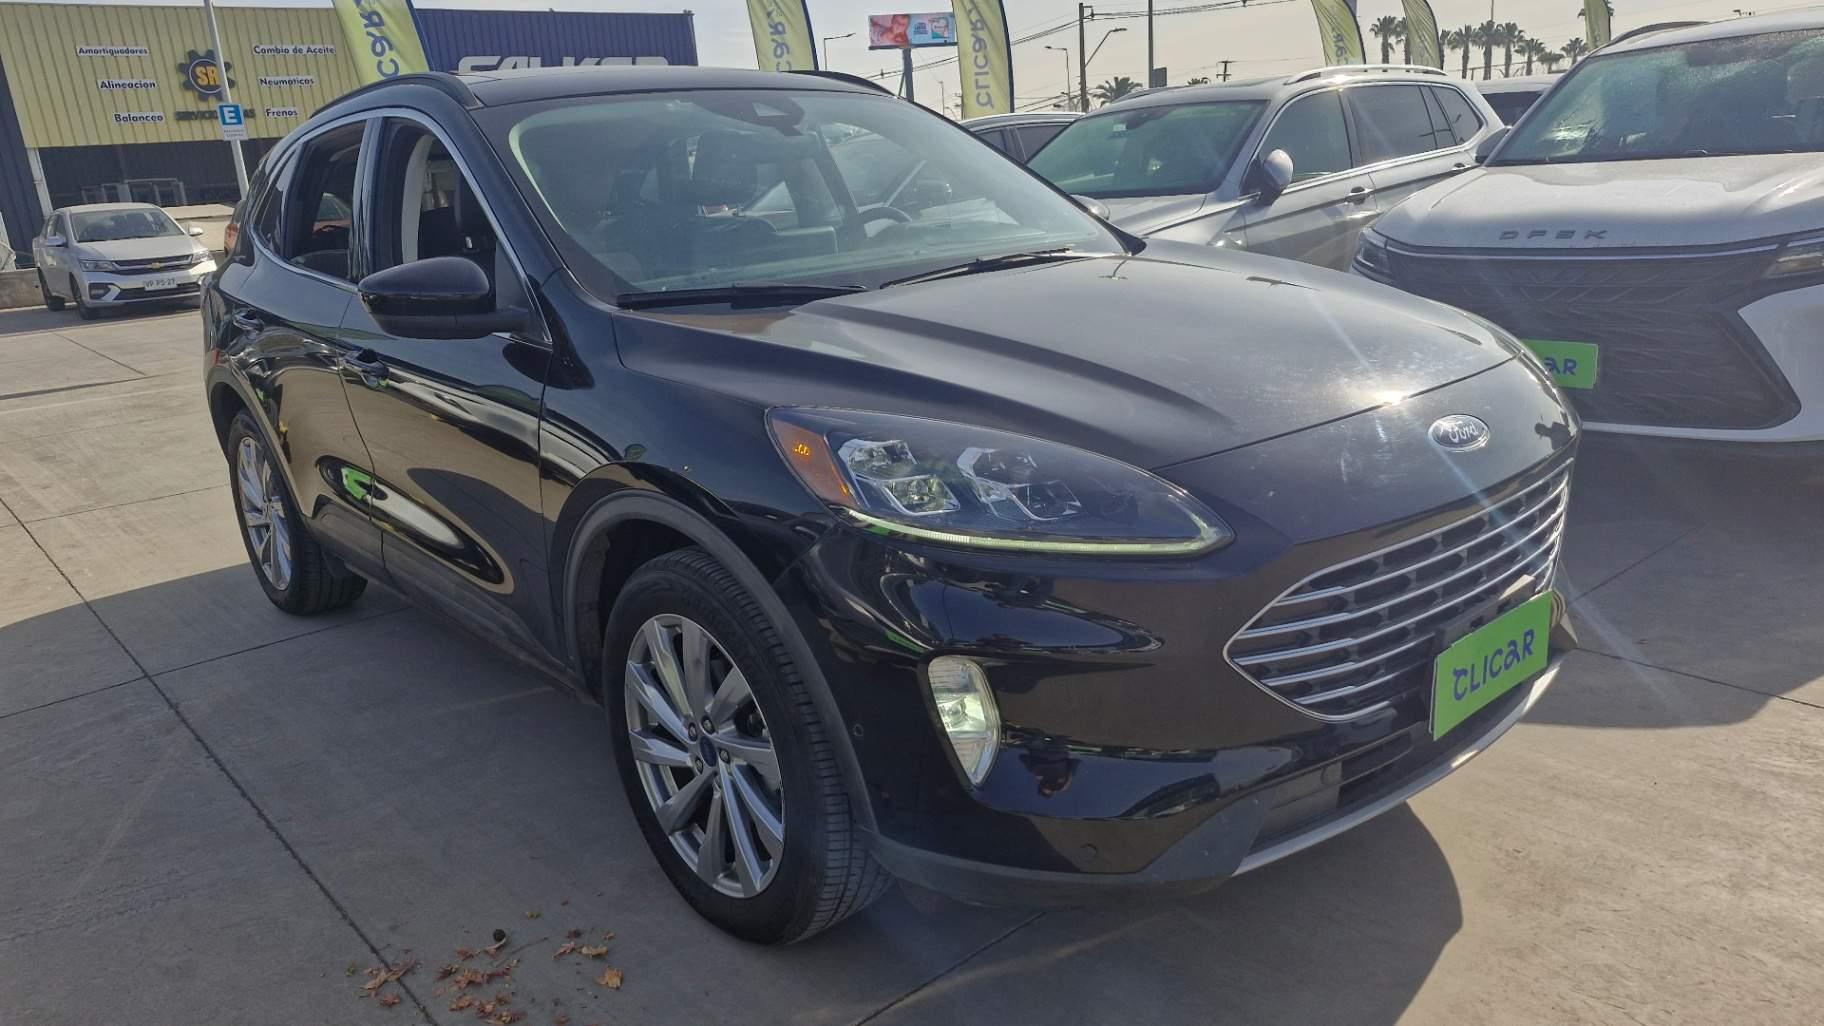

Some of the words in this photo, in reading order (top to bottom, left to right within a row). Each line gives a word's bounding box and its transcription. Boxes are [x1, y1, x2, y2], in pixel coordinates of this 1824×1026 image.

[79, 47, 148, 56] Amortiguadores
[253, 45, 290, 54] Cambio
[292, 45, 304, 54] de
[306, 45, 335, 54] Aceite
[223, 107, 237, 123] E
[266, 108, 298, 117] Frenos
[114, 113, 164, 122] Balanceo
